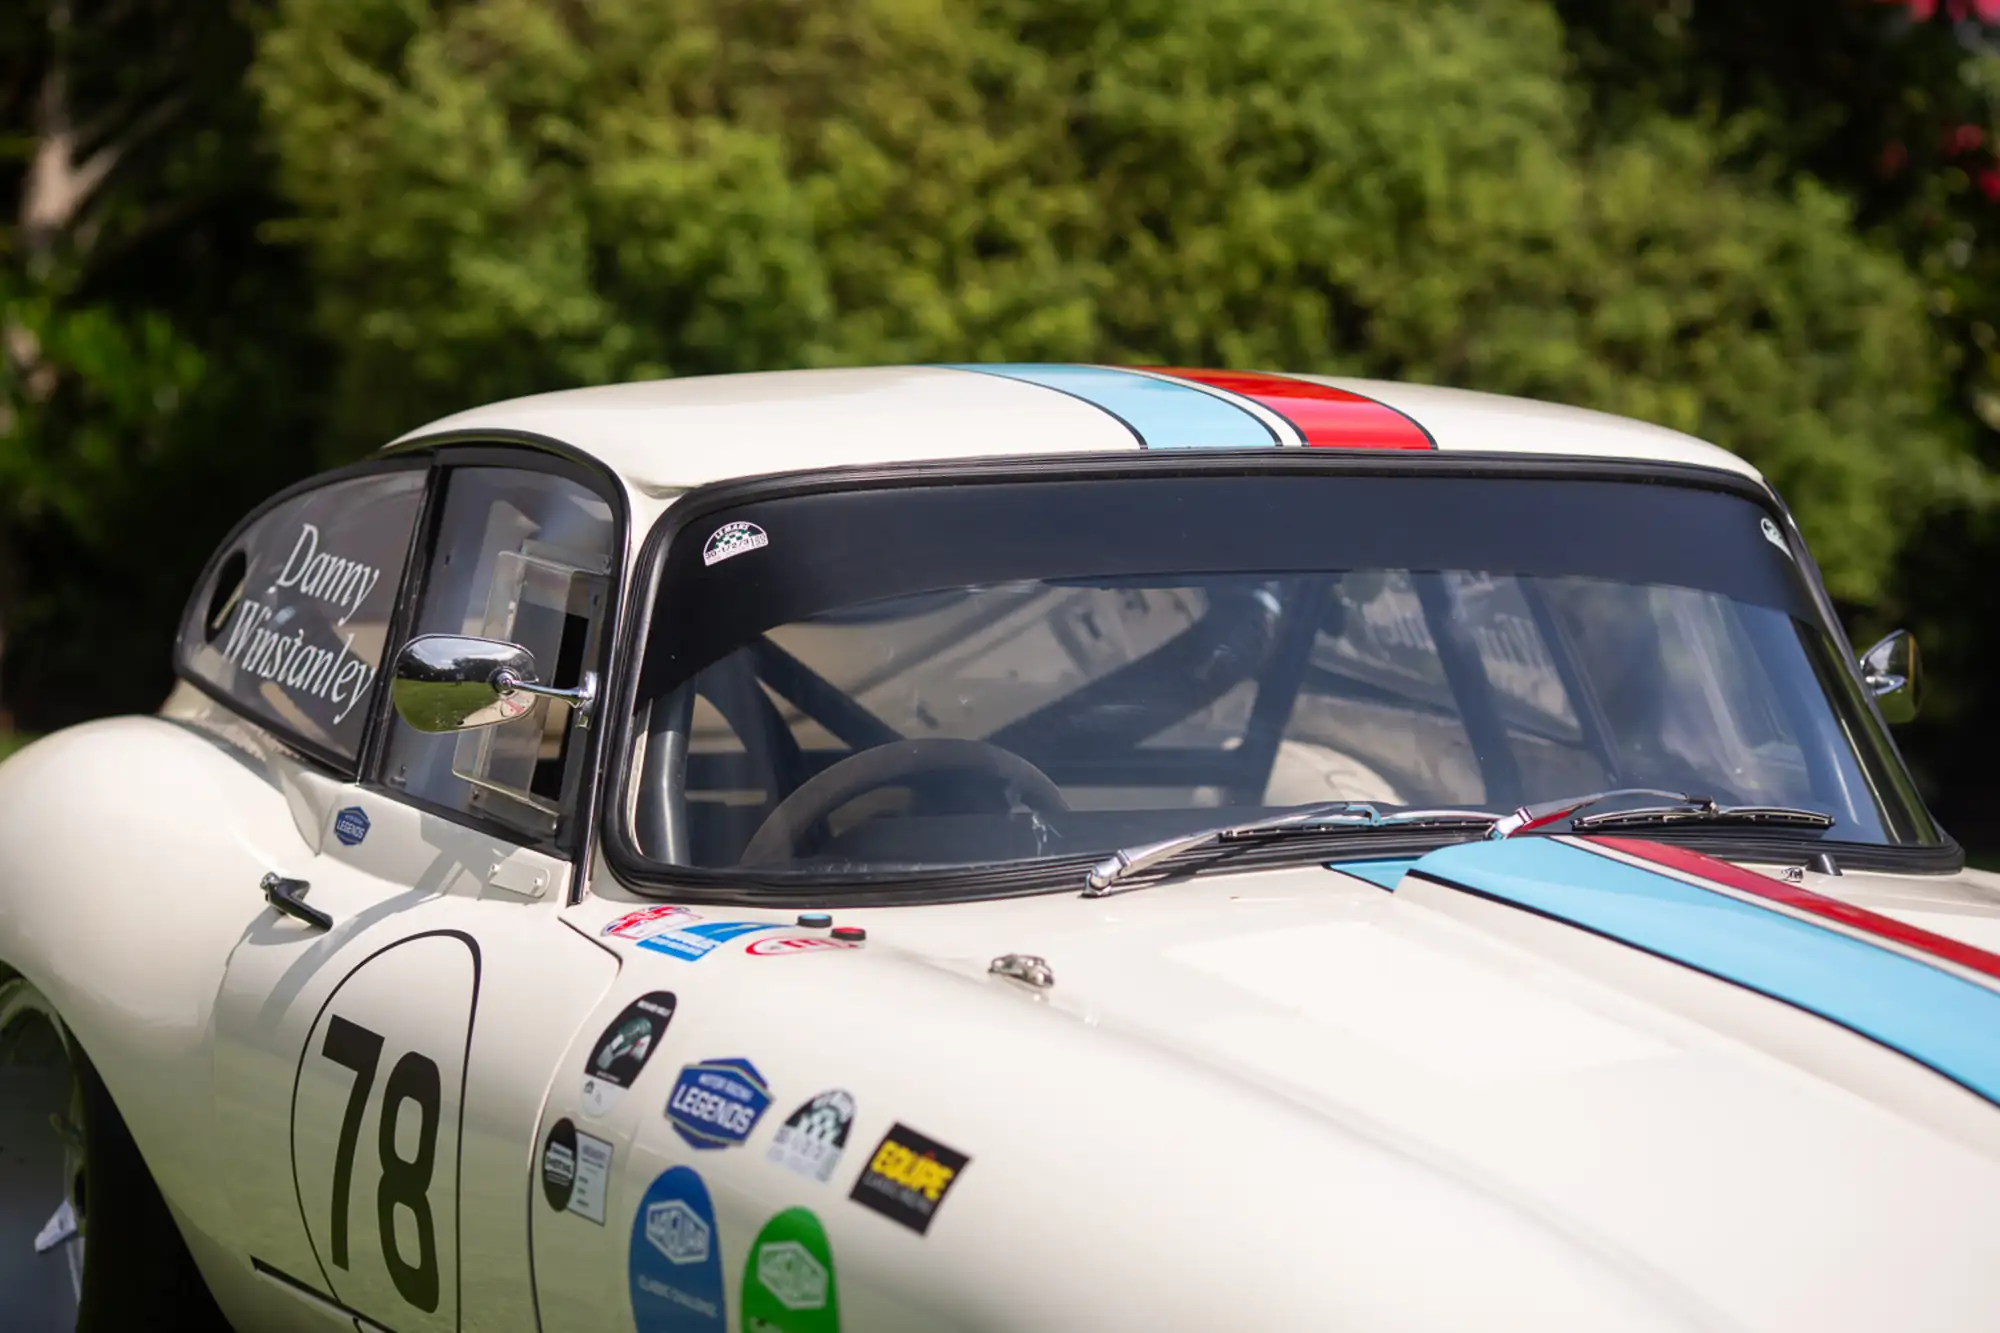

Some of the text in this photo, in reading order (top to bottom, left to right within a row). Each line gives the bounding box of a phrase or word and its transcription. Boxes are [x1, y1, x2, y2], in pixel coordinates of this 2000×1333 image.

[276, 523, 381, 627] Danny
[223, 599, 376, 724] Winstanley
[336, 819, 366, 839] LEGENDS
[671, 1083, 756, 1135] LEGENDS
[321, 1013, 442, 1313] 78
